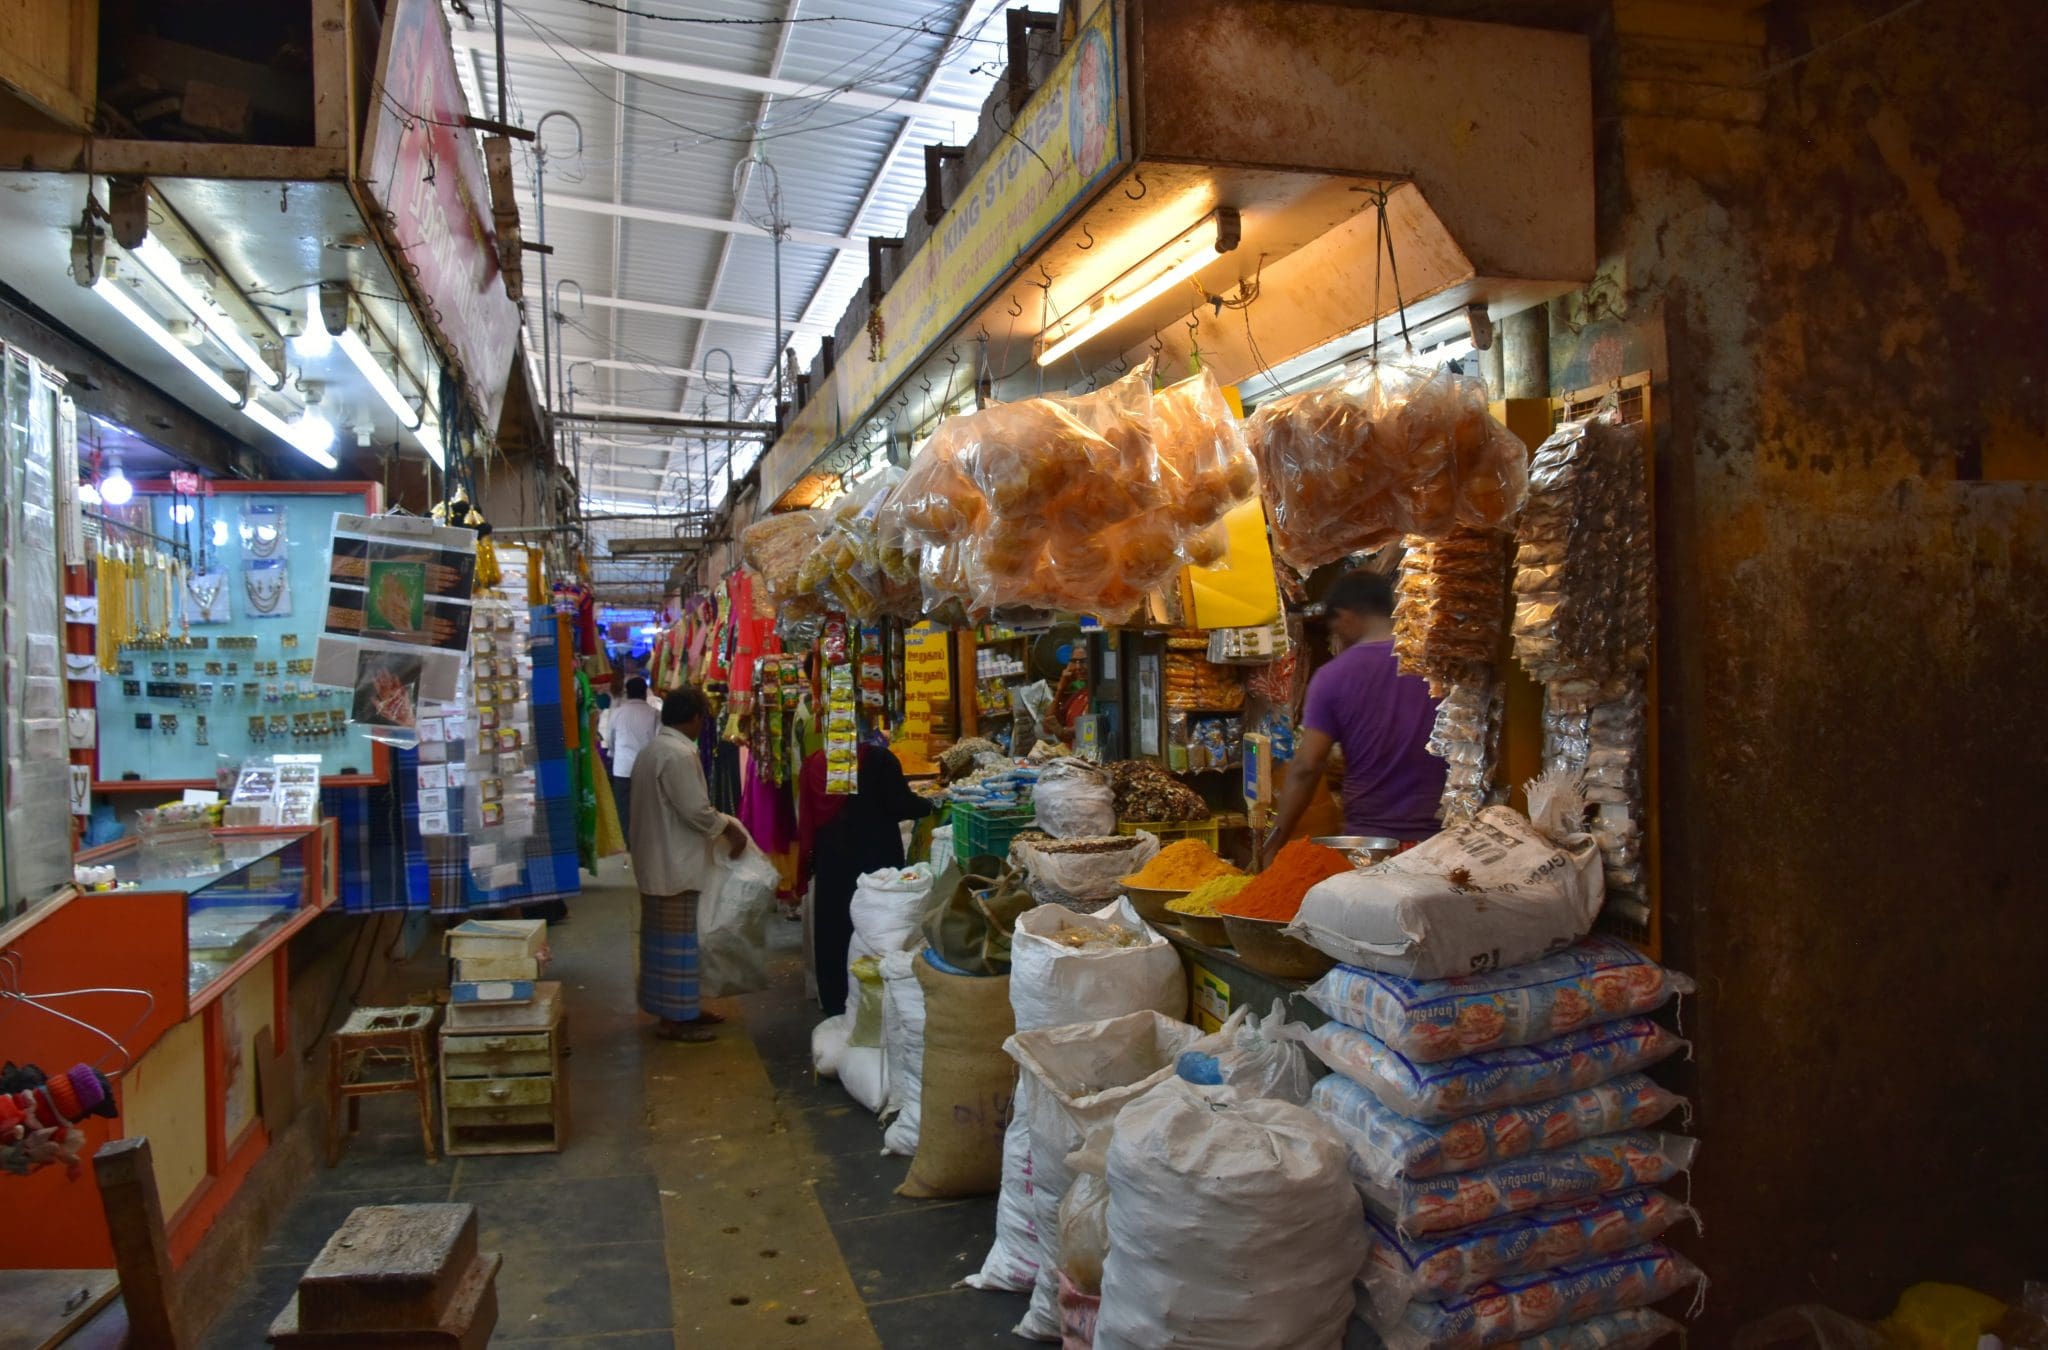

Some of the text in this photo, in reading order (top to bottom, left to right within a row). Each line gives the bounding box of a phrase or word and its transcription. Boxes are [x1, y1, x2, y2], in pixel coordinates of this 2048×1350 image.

[943, 193, 981, 260] KING
[985, 86, 1064, 208] STORES
[1523, 854, 1567, 886] Grade
[1404, 1003, 1453, 1022] yngaran
